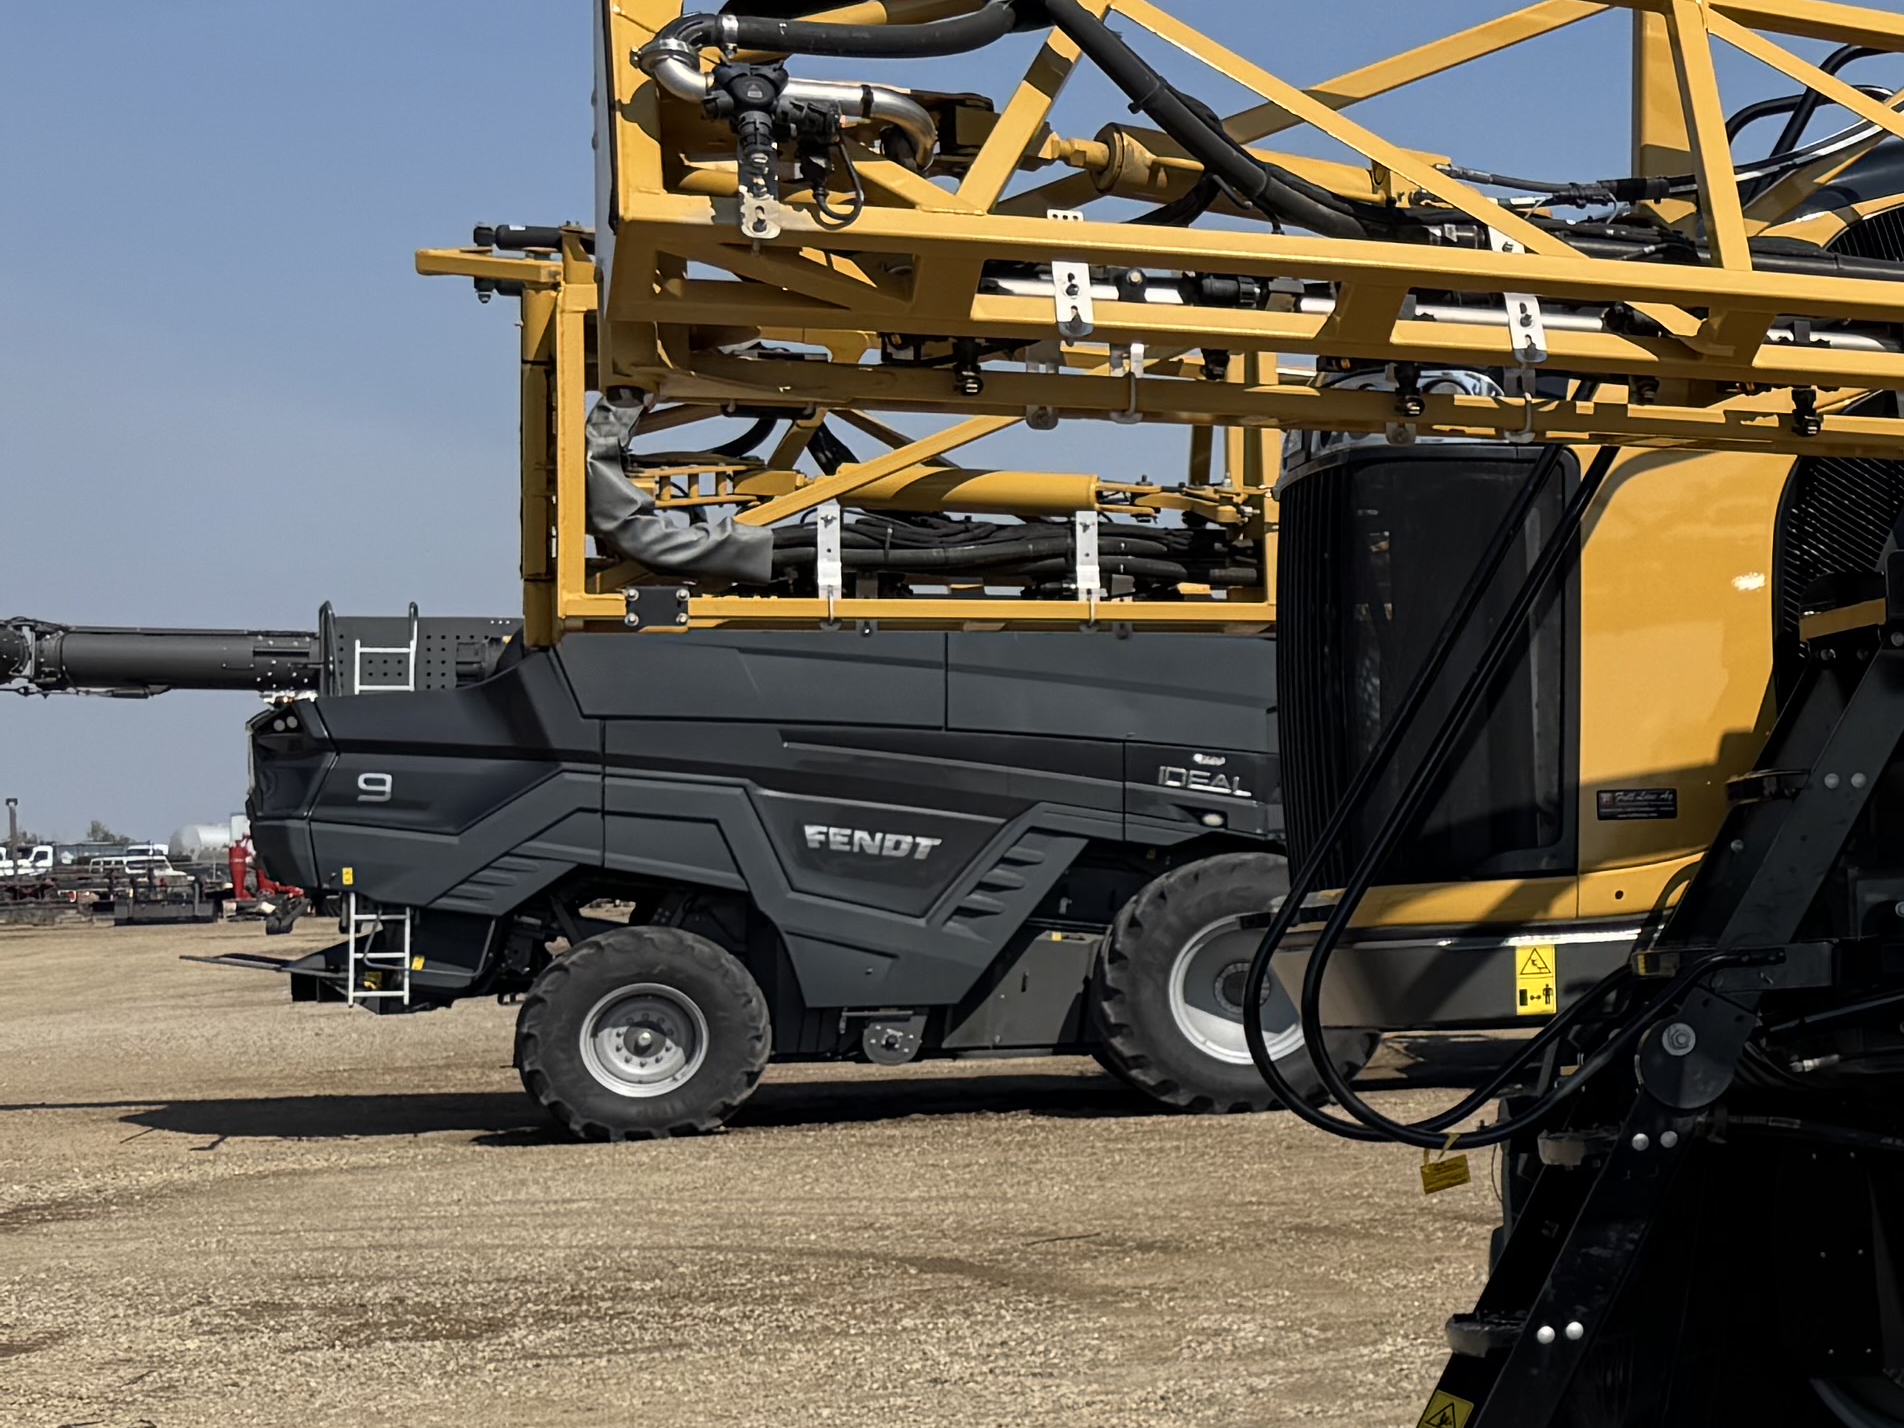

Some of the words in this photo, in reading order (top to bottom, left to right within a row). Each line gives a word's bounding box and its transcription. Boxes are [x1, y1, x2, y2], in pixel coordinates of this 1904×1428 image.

[357, 772, 393, 802] 9
[1158, 765, 1252, 797] IDEAL
[803, 824, 943, 860] FENDT
